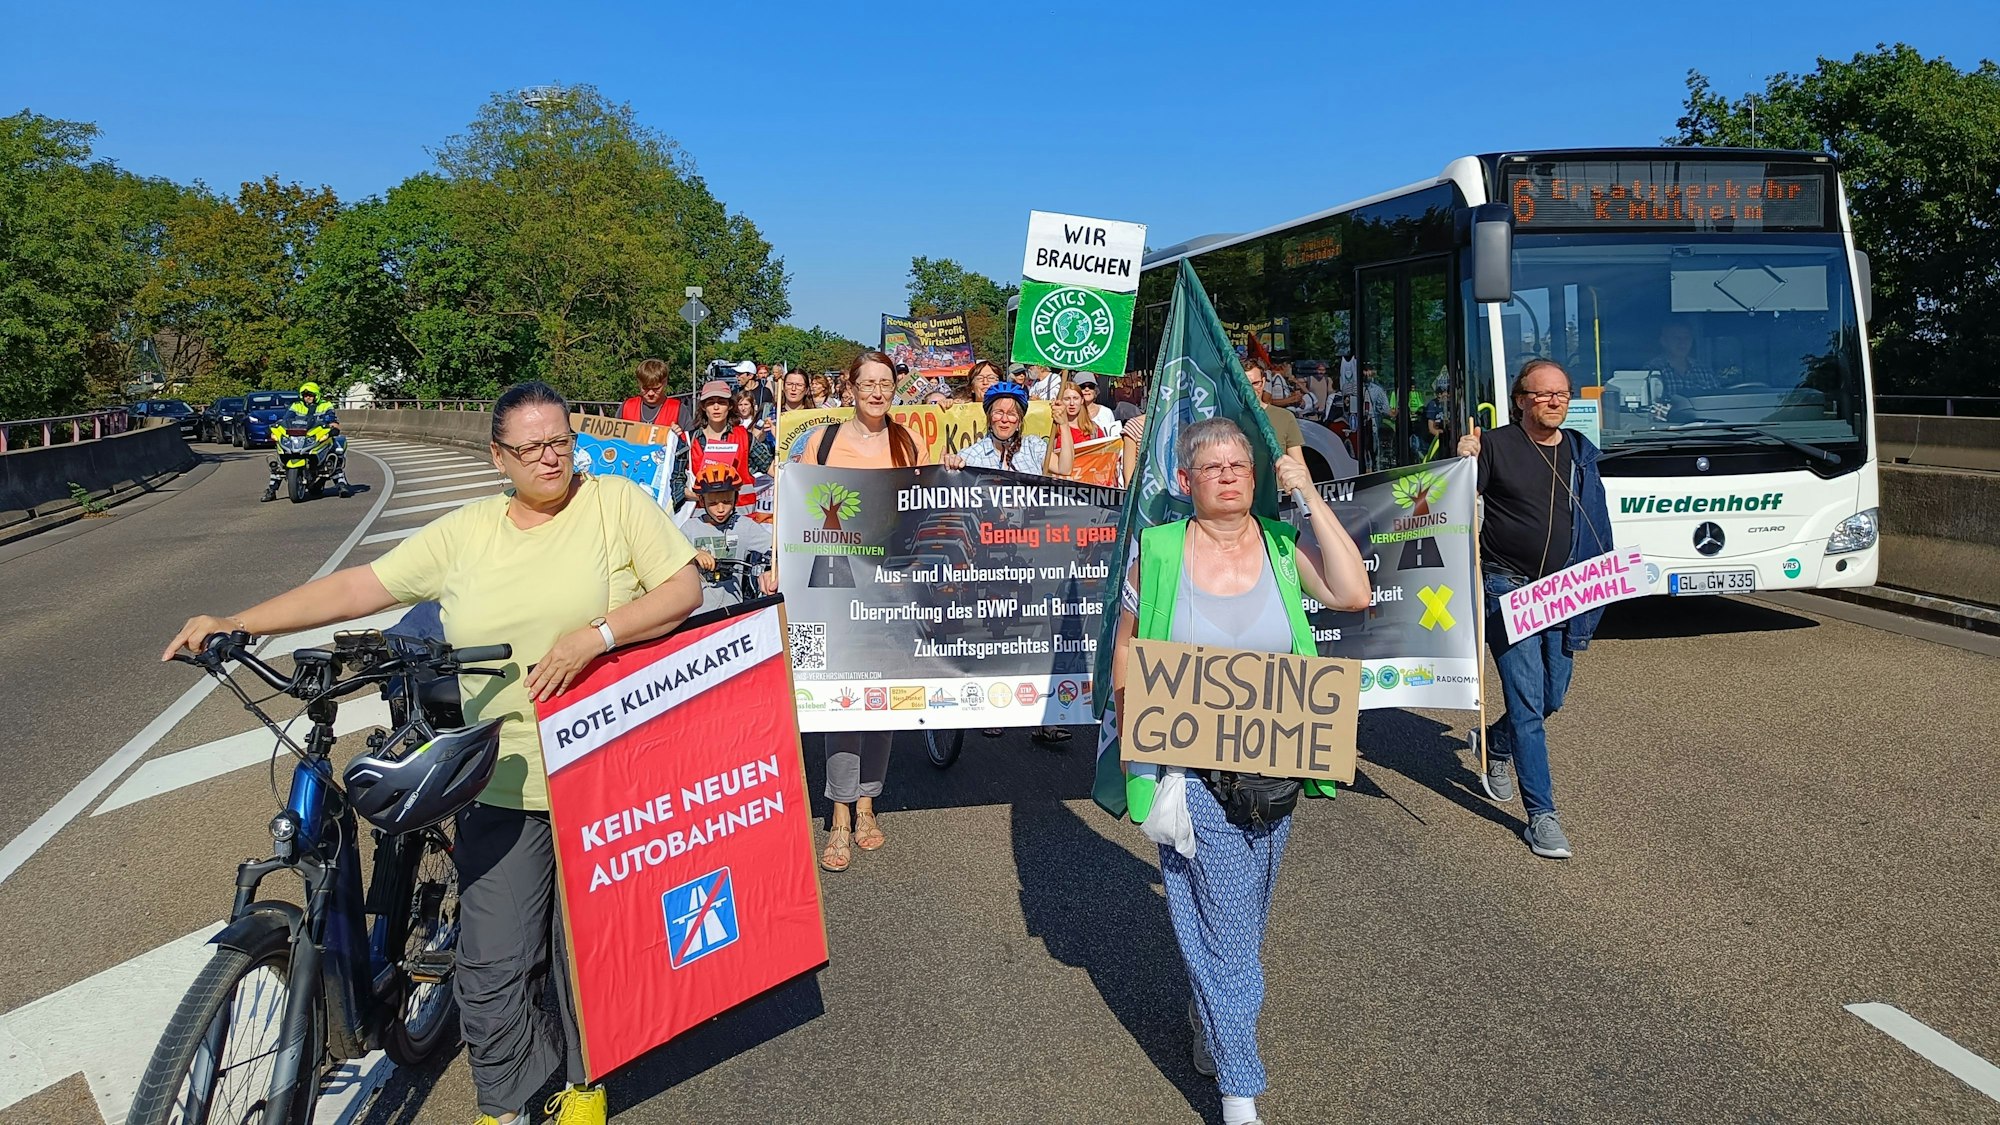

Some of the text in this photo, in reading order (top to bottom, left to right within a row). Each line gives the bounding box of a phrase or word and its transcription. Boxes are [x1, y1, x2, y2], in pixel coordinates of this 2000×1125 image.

[1512, 178, 1801, 223] 6 Ersatzverkehr
[1064, 223, 1106, 247] WIR
[1036, 248, 1131, 277] BRAUCHEN
[929, 315, 963, 328] Umwelt
[1035, 291, 1087, 336] POLITICS
[1091, 307, 1109, 336] FOR
[920, 335, 967, 346] Wirtschaft
[938, 326, 965, 337] Profit-
[1045, 340, 1101, 364] FUTURE
[580, 417, 667, 445] FINDET NEM
[780, 414, 842, 451] Unbegrenztes
[897, 486, 983, 512] BÜNDNIS
[988, 485, 1127, 508] VERKEHRSINIT
[1620, 492, 1783, 514] Wiedenhoff
[1370, 524, 1471, 544] VERKEHRSINITVEN
[1393, 511, 1448, 532] BÜNDNIS
[1748, 525, 1785, 533] CITARO
[803, 527, 862, 544] BÜNDNIS
[980, 522, 1117, 548] Genug ist gen
[784, 543, 885, 556] VERHRSINITIATIVEN
[874, 565, 907, 584] Aus-
[912, 564, 939, 583] und
[943, 563, 1036, 585] Neubaustopp
[1039, 567, 1064, 580] von
[1068, 560, 1109, 579] Autob
[1782, 562, 1797, 570] VRS
[1679, 573, 1753, 590] GL GW 335
[850, 600, 942, 623] Überprüfung
[947, 600, 973, 620] des
[977, 599, 1018, 619] BVWP
[1021, 597, 1048, 617] und
[1052, 596, 1104, 616] Bundes
[914, 638, 1049, 659] Zukunftsgerechtes
[1053, 633, 1098, 653] Bunde
[556, 634, 754, 749] ROTE KLIMAKARTE
[1436, 675, 1479, 684] RADKOMM
[1132, 706, 1333, 772] GO HOME
[581, 754, 780, 852] KEINE NEUEN
[589, 791, 784, 893] AUTOBAHNEN
